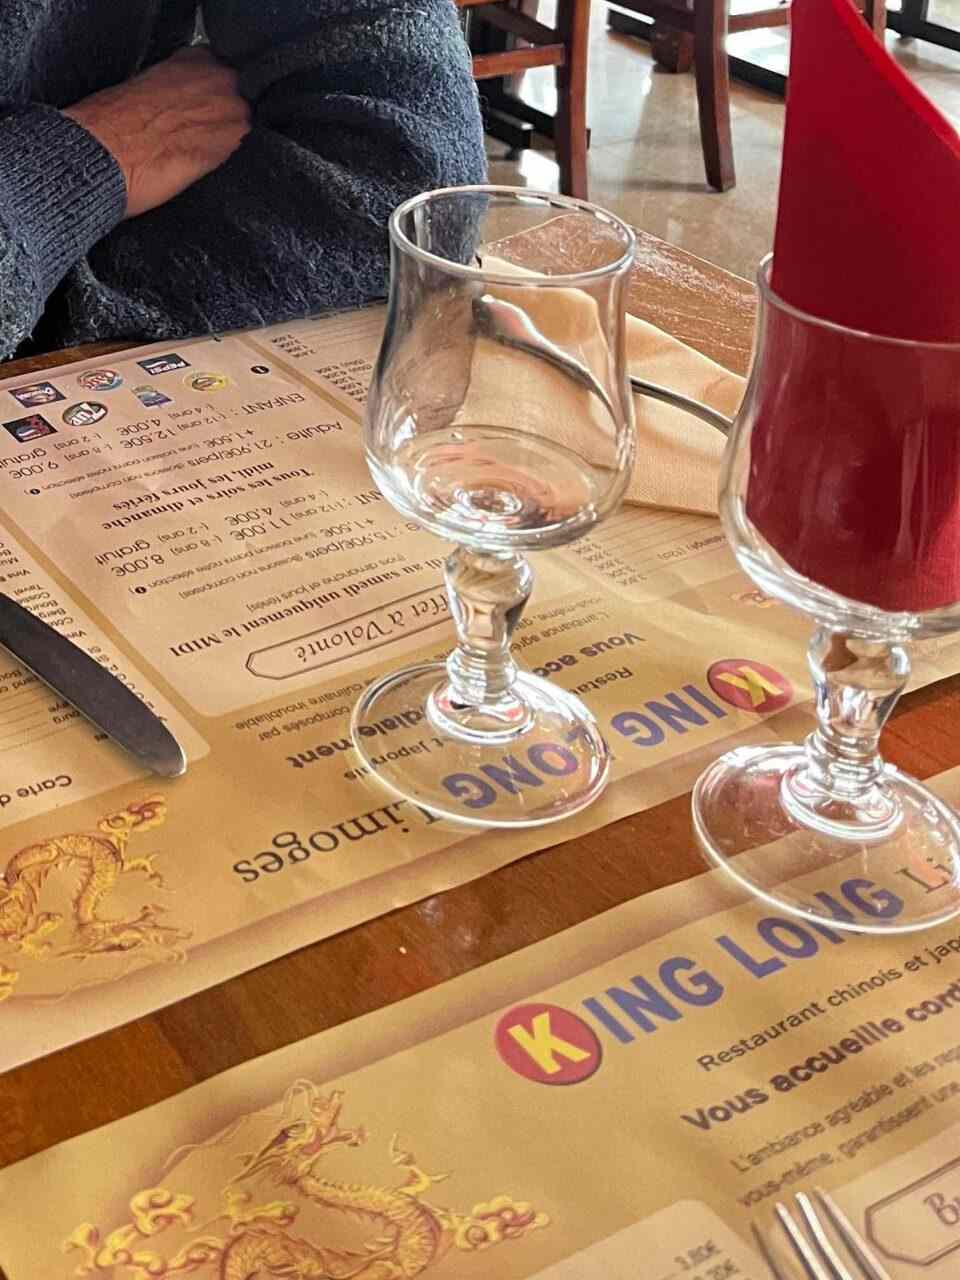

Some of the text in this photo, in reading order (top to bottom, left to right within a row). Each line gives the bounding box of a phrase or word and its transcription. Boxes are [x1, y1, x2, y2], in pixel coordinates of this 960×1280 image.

[286, 421, 343, 440] Adulte
[207, 474, 233, 483] les
[248, 479, 273, 488] les
[272, 469, 314, 481] Tous
[161, 479, 207, 495] jours
[206, 486, 246, 500] soirs
[102, 502, 184, 529] dimanche
[94, 539, 150, 564] gratuit
[111, 554, 165, 577] 8,00€
[342, 571, 400, 597] samedi
[241, 591, 341, 632] uniquement
[387, 610, 405, 626] à
[222, 627, 241, 637] le
[297, 621, 393, 663] Volonté
[170, 634, 222, 657] MIDI
[579, 633, 646, 658] Vous
[16, 775, 72, 798] Carte
[507, 956, 725, 1076] KING
[697, 1002, 826, 1071] Restaurant
[827, 967, 903, 1008] chinois
[904, 954, 928, 972] et
[681, 1087, 770, 1131] Vous
[770, 1017, 904, 1093] accueille
